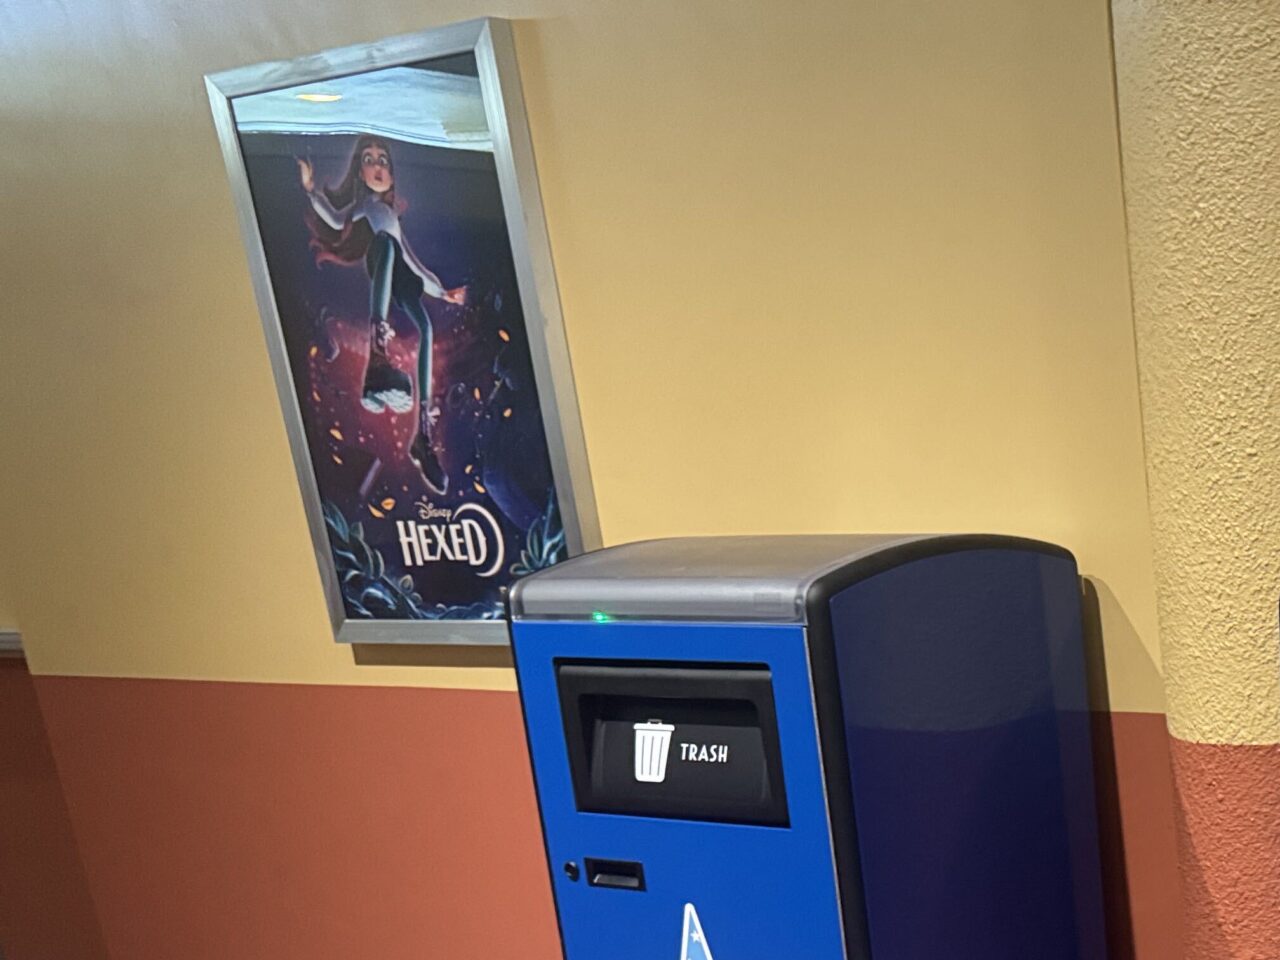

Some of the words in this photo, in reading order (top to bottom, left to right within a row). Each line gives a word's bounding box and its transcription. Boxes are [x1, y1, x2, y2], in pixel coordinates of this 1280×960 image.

[414, 501, 452, 523] Disney
[395, 518, 488, 567] HEXED
[680, 743, 728, 763] TRASH
